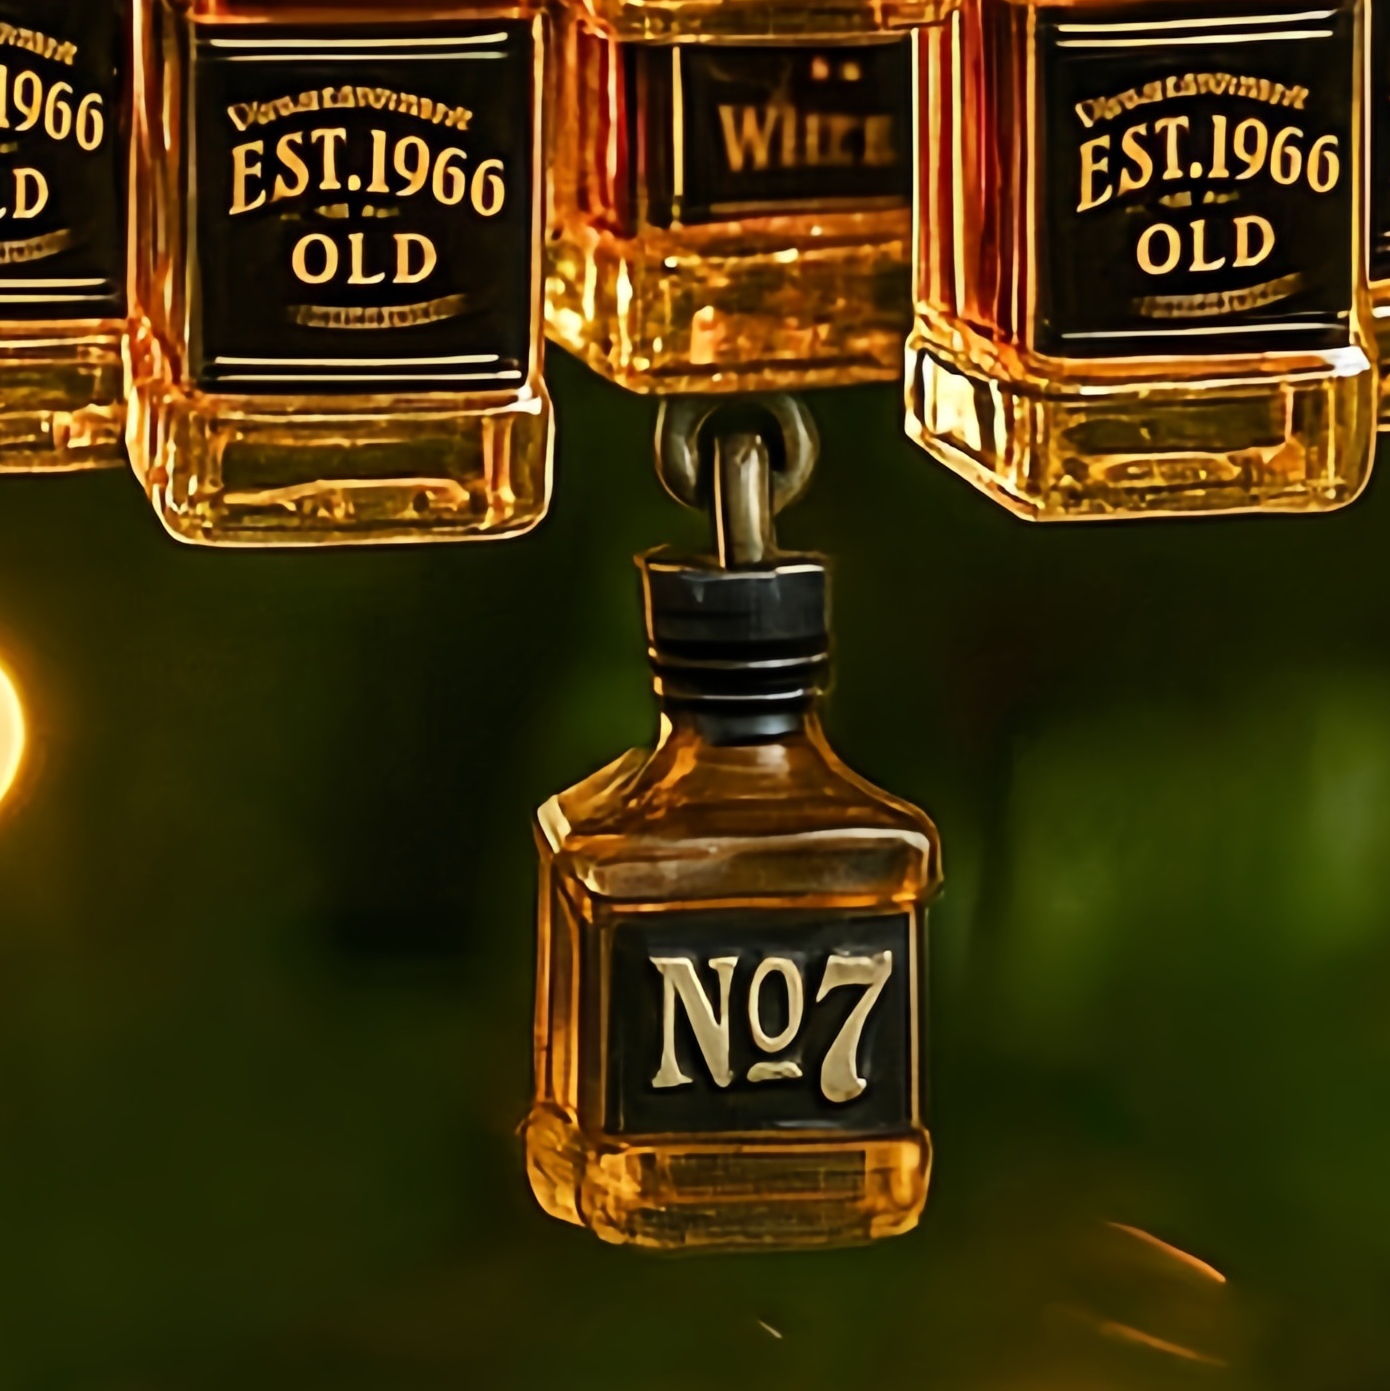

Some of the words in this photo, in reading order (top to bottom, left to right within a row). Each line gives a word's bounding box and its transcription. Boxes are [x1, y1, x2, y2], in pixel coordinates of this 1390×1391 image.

[228, 127, 506, 217] EST.1966
[1076, 114, 1340, 213] EST.1966
[291, 232, 438, 285] OLD
[1135, 214, 1277, 276] OLD
